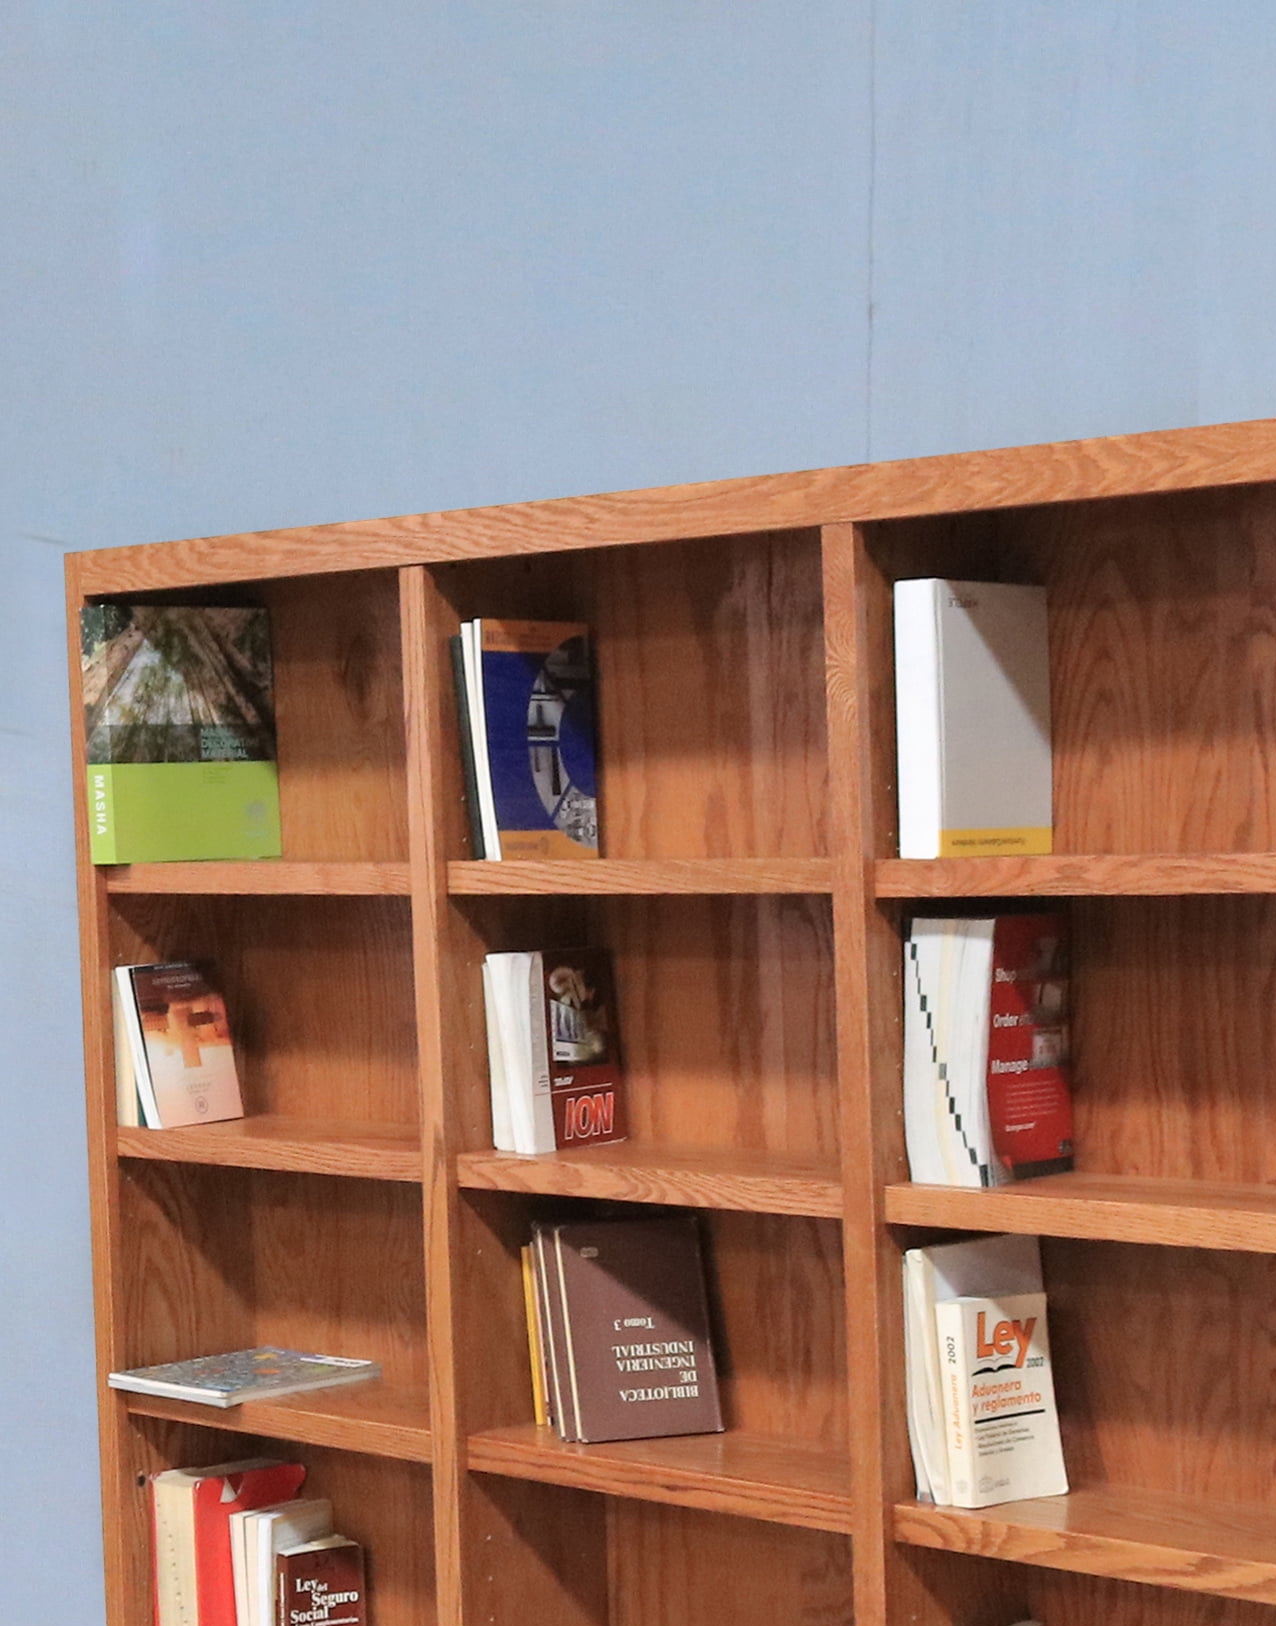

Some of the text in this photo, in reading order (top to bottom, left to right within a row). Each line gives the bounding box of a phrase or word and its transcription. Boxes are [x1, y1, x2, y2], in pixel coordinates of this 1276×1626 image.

[94, 774, 108, 836] MASHA
[994, 966, 1017, 984] Shop
[992, 1012, 1019, 1029] Order
[990, 1058, 1030, 1076] Manage
[565, 1091, 616, 1141] ION
[613, 1316, 655, 1332] Tomo 3
[977, 1310, 1038, 1369] Ley
[611, 1340, 694, 1359] INDUSTRIAL
[945, 1335, 958, 1365] 2002
[616, 1354, 696, 1372] INGENIERIA
[679, 1369, 697, 1383] DE
[619, 1384, 699, 1402] BIBLIOTECA
[971, 1380, 1022, 1398] Aduanera
[949, 1373, 963, 1451] Ley Aduanera
[981, 1391, 1042, 1415] reglamento
[295, 1577, 318, 1595] Ley
[311, 1591, 359, 1608] Seguro
[290, 1606, 329, 1625] Social
